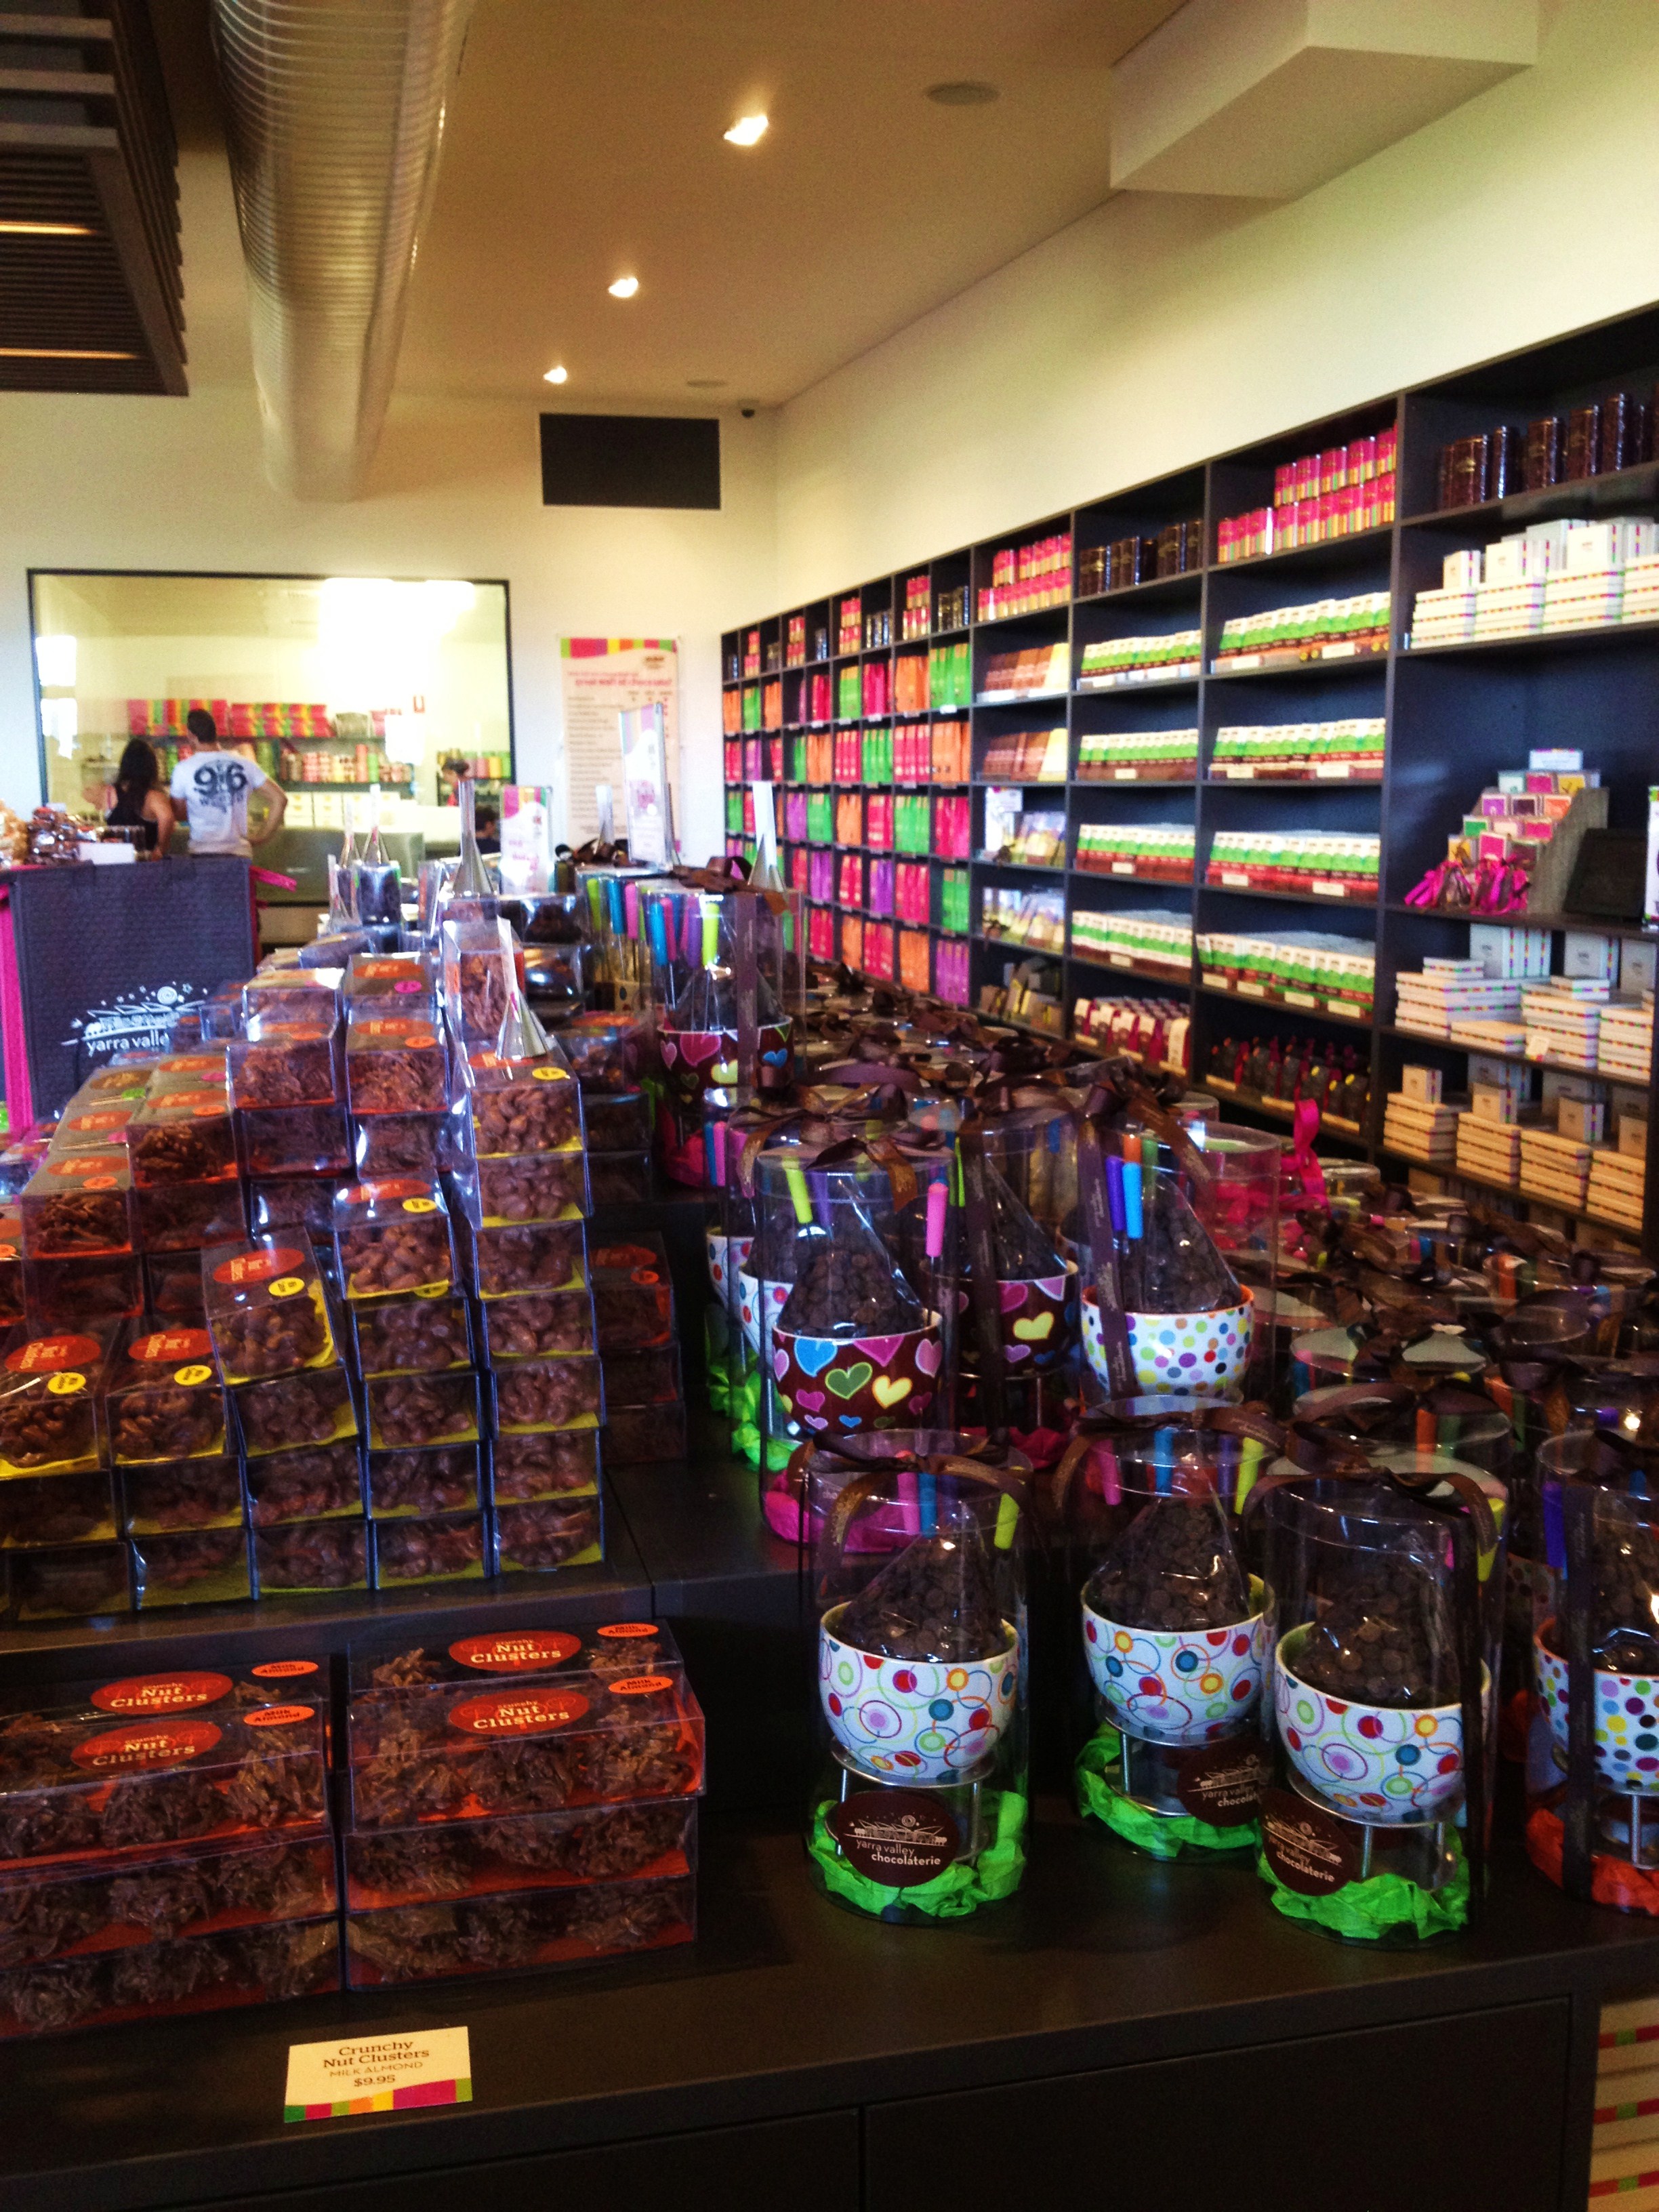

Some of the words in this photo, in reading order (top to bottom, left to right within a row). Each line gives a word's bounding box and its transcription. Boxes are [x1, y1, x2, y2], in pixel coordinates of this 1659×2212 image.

[87, 1038, 129, 1057] yarra
[131, 1029, 168, 1048] valle
[496, 1643, 533, 1653] Nut
[470, 1650, 562, 1664] Clusters
[141, 1686, 182, 1697] Nut
[110, 1694, 207, 1707] Clusters
[499, 1705, 540, 1717] Nut
[473, 1711, 570, 1729] Clusters
[125, 1739, 167, 1753] Nut
[92, 1745, 195, 1766] Clusters
[856, 1839, 882, 1851] yarra
[884, 1844, 915, 1858] valley
[871, 1851, 941, 1866] chocolaterie
[1276, 1851, 1335, 1883] chocolaterie
[338, 2041, 414, 2056] Crunchy
[323, 2057, 354, 2068] Nut
[359, 2049, 430, 2064] Clusters
[363, 2061, 424, 2074] ALMOND
[353, 2074, 396, 2088] $9.95
